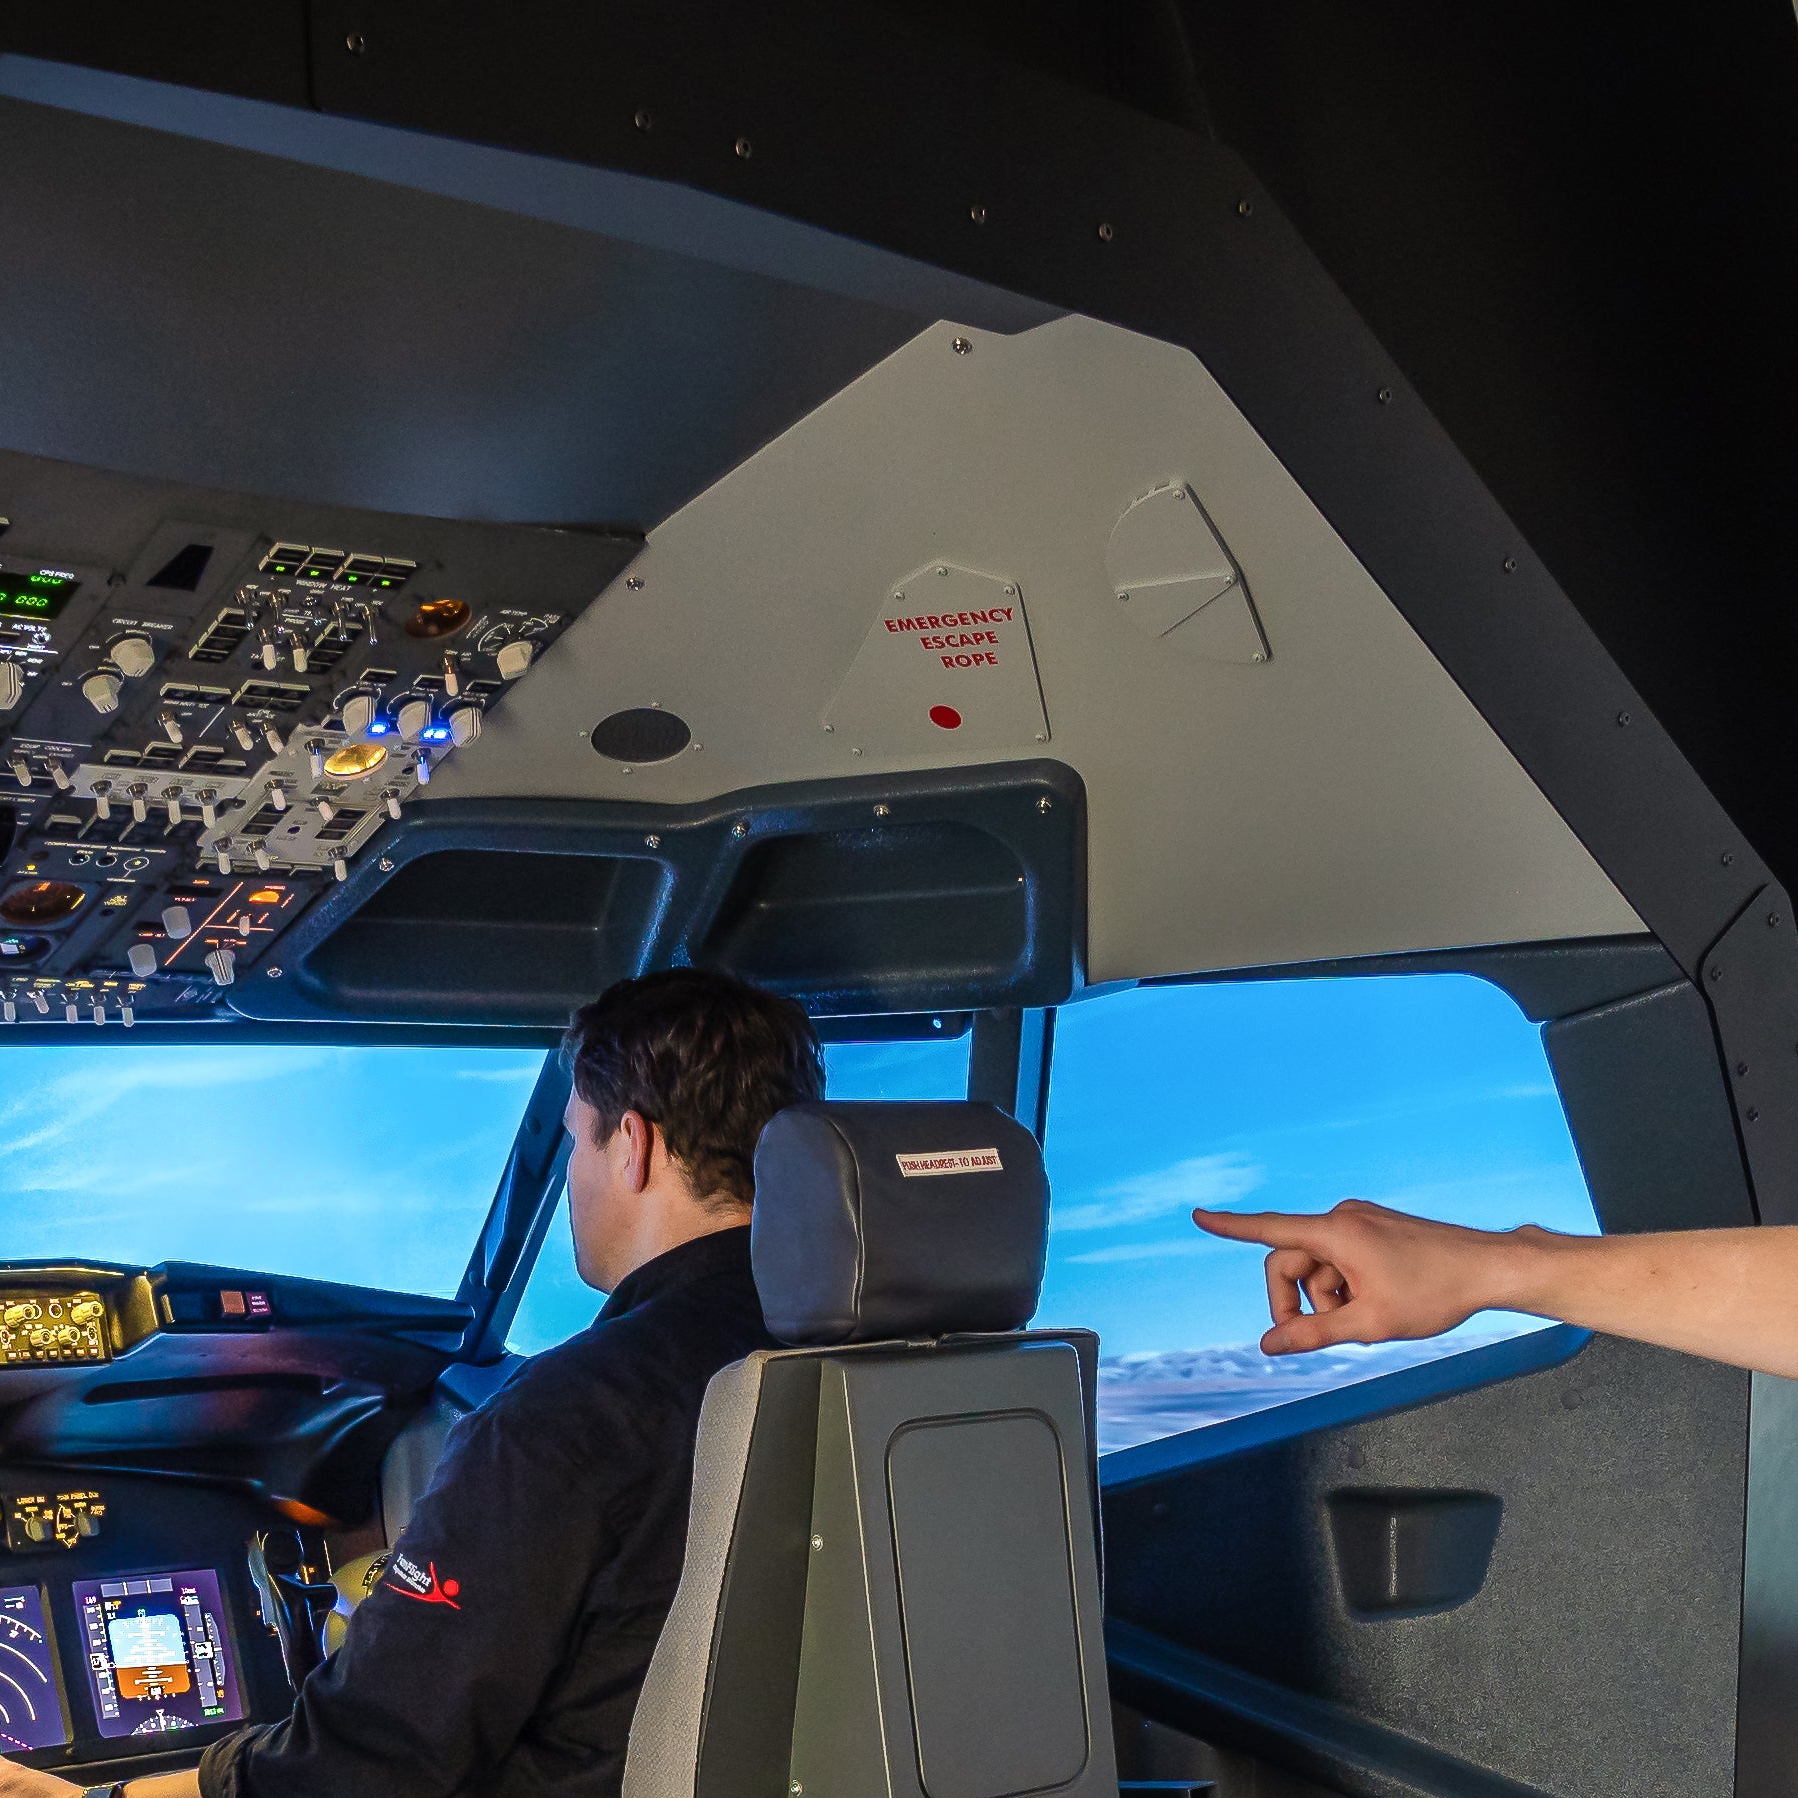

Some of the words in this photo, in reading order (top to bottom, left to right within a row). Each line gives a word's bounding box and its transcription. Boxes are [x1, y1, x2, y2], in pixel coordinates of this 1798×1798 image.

[884, 606, 1014, 635] EMERGENCY
[920, 630, 1000, 651] ESCAPE
[940, 650, 1000, 670] ROPE
[902, 1160, 921, 1171] PUSH
[960, 1156, 970, 1167] TO
[970, 1155, 998, 1167] ADJUST
